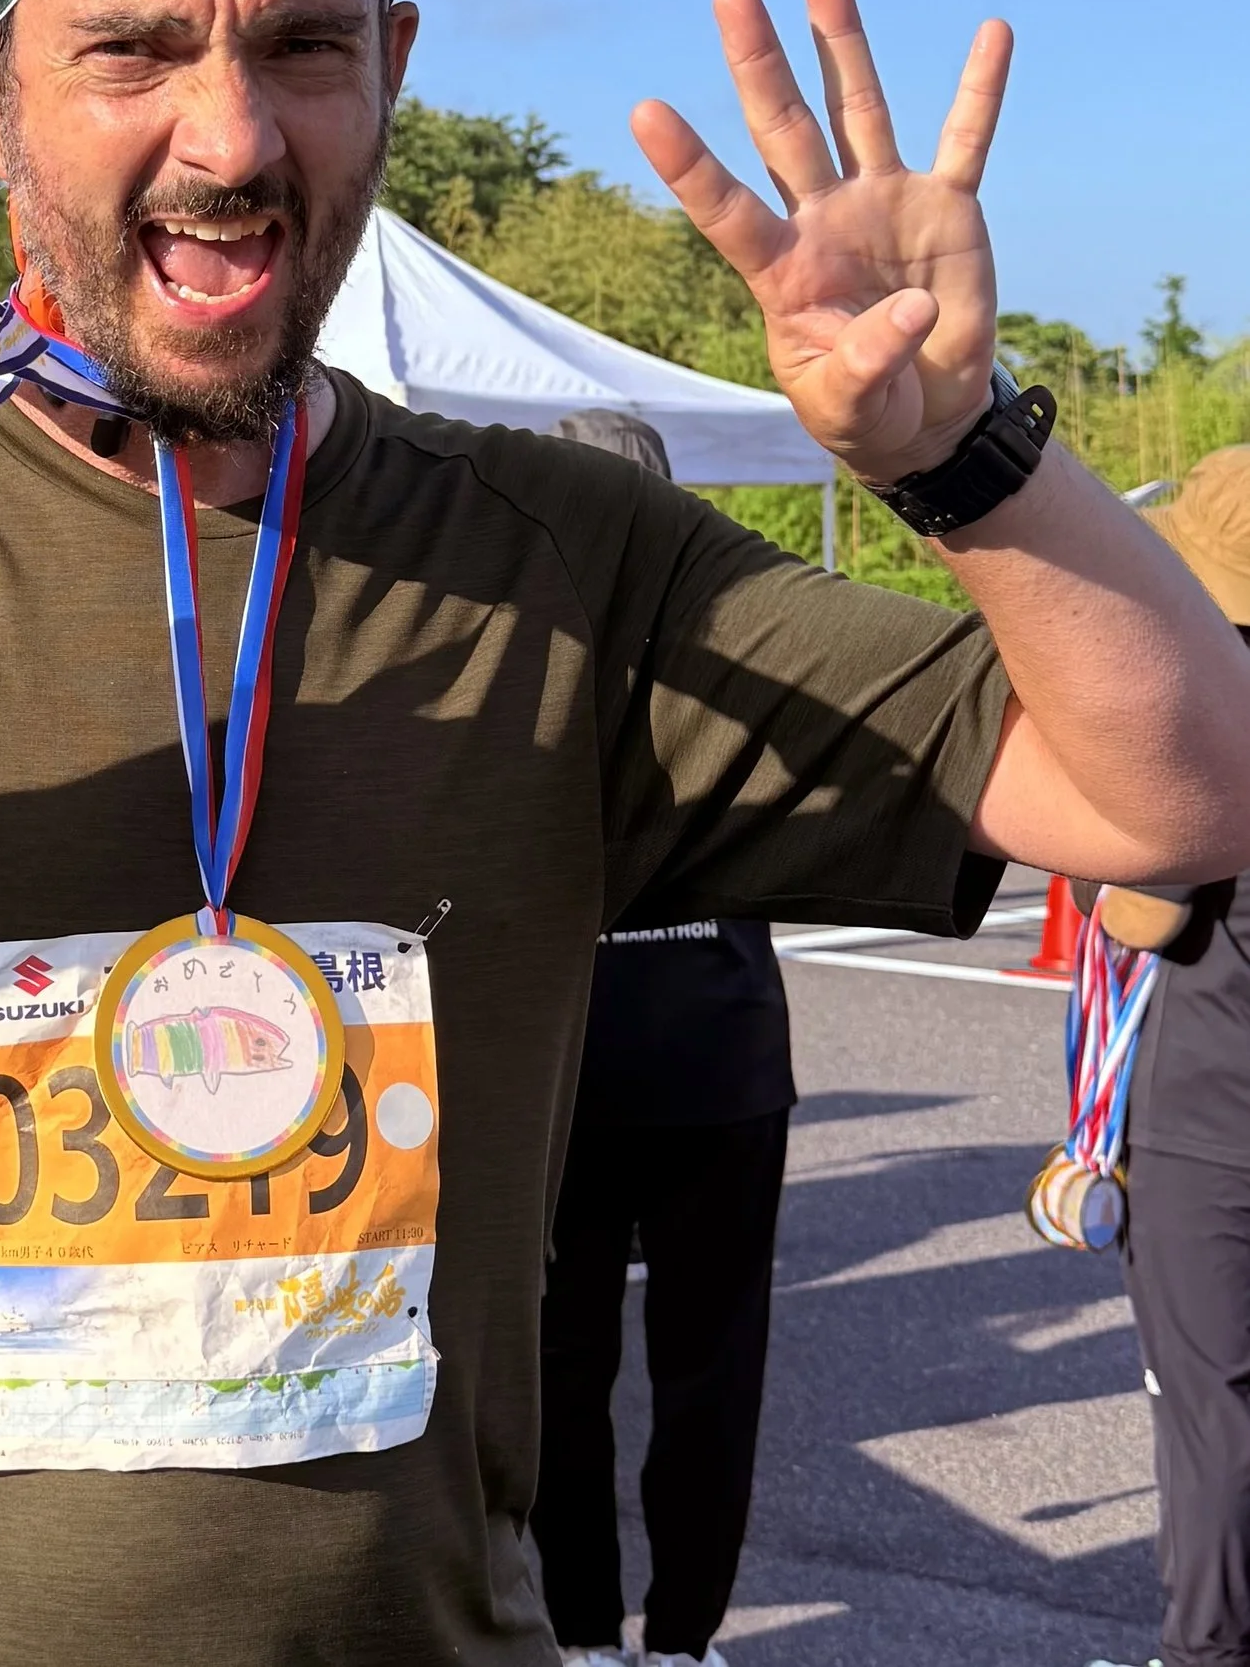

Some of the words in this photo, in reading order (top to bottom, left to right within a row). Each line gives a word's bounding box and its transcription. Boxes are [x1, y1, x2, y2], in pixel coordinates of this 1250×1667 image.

[358, 1229, 391, 1244] START
[396, 1227, 424, 1240] 11:30
[232, 1237, 293, 1253] リチャード
